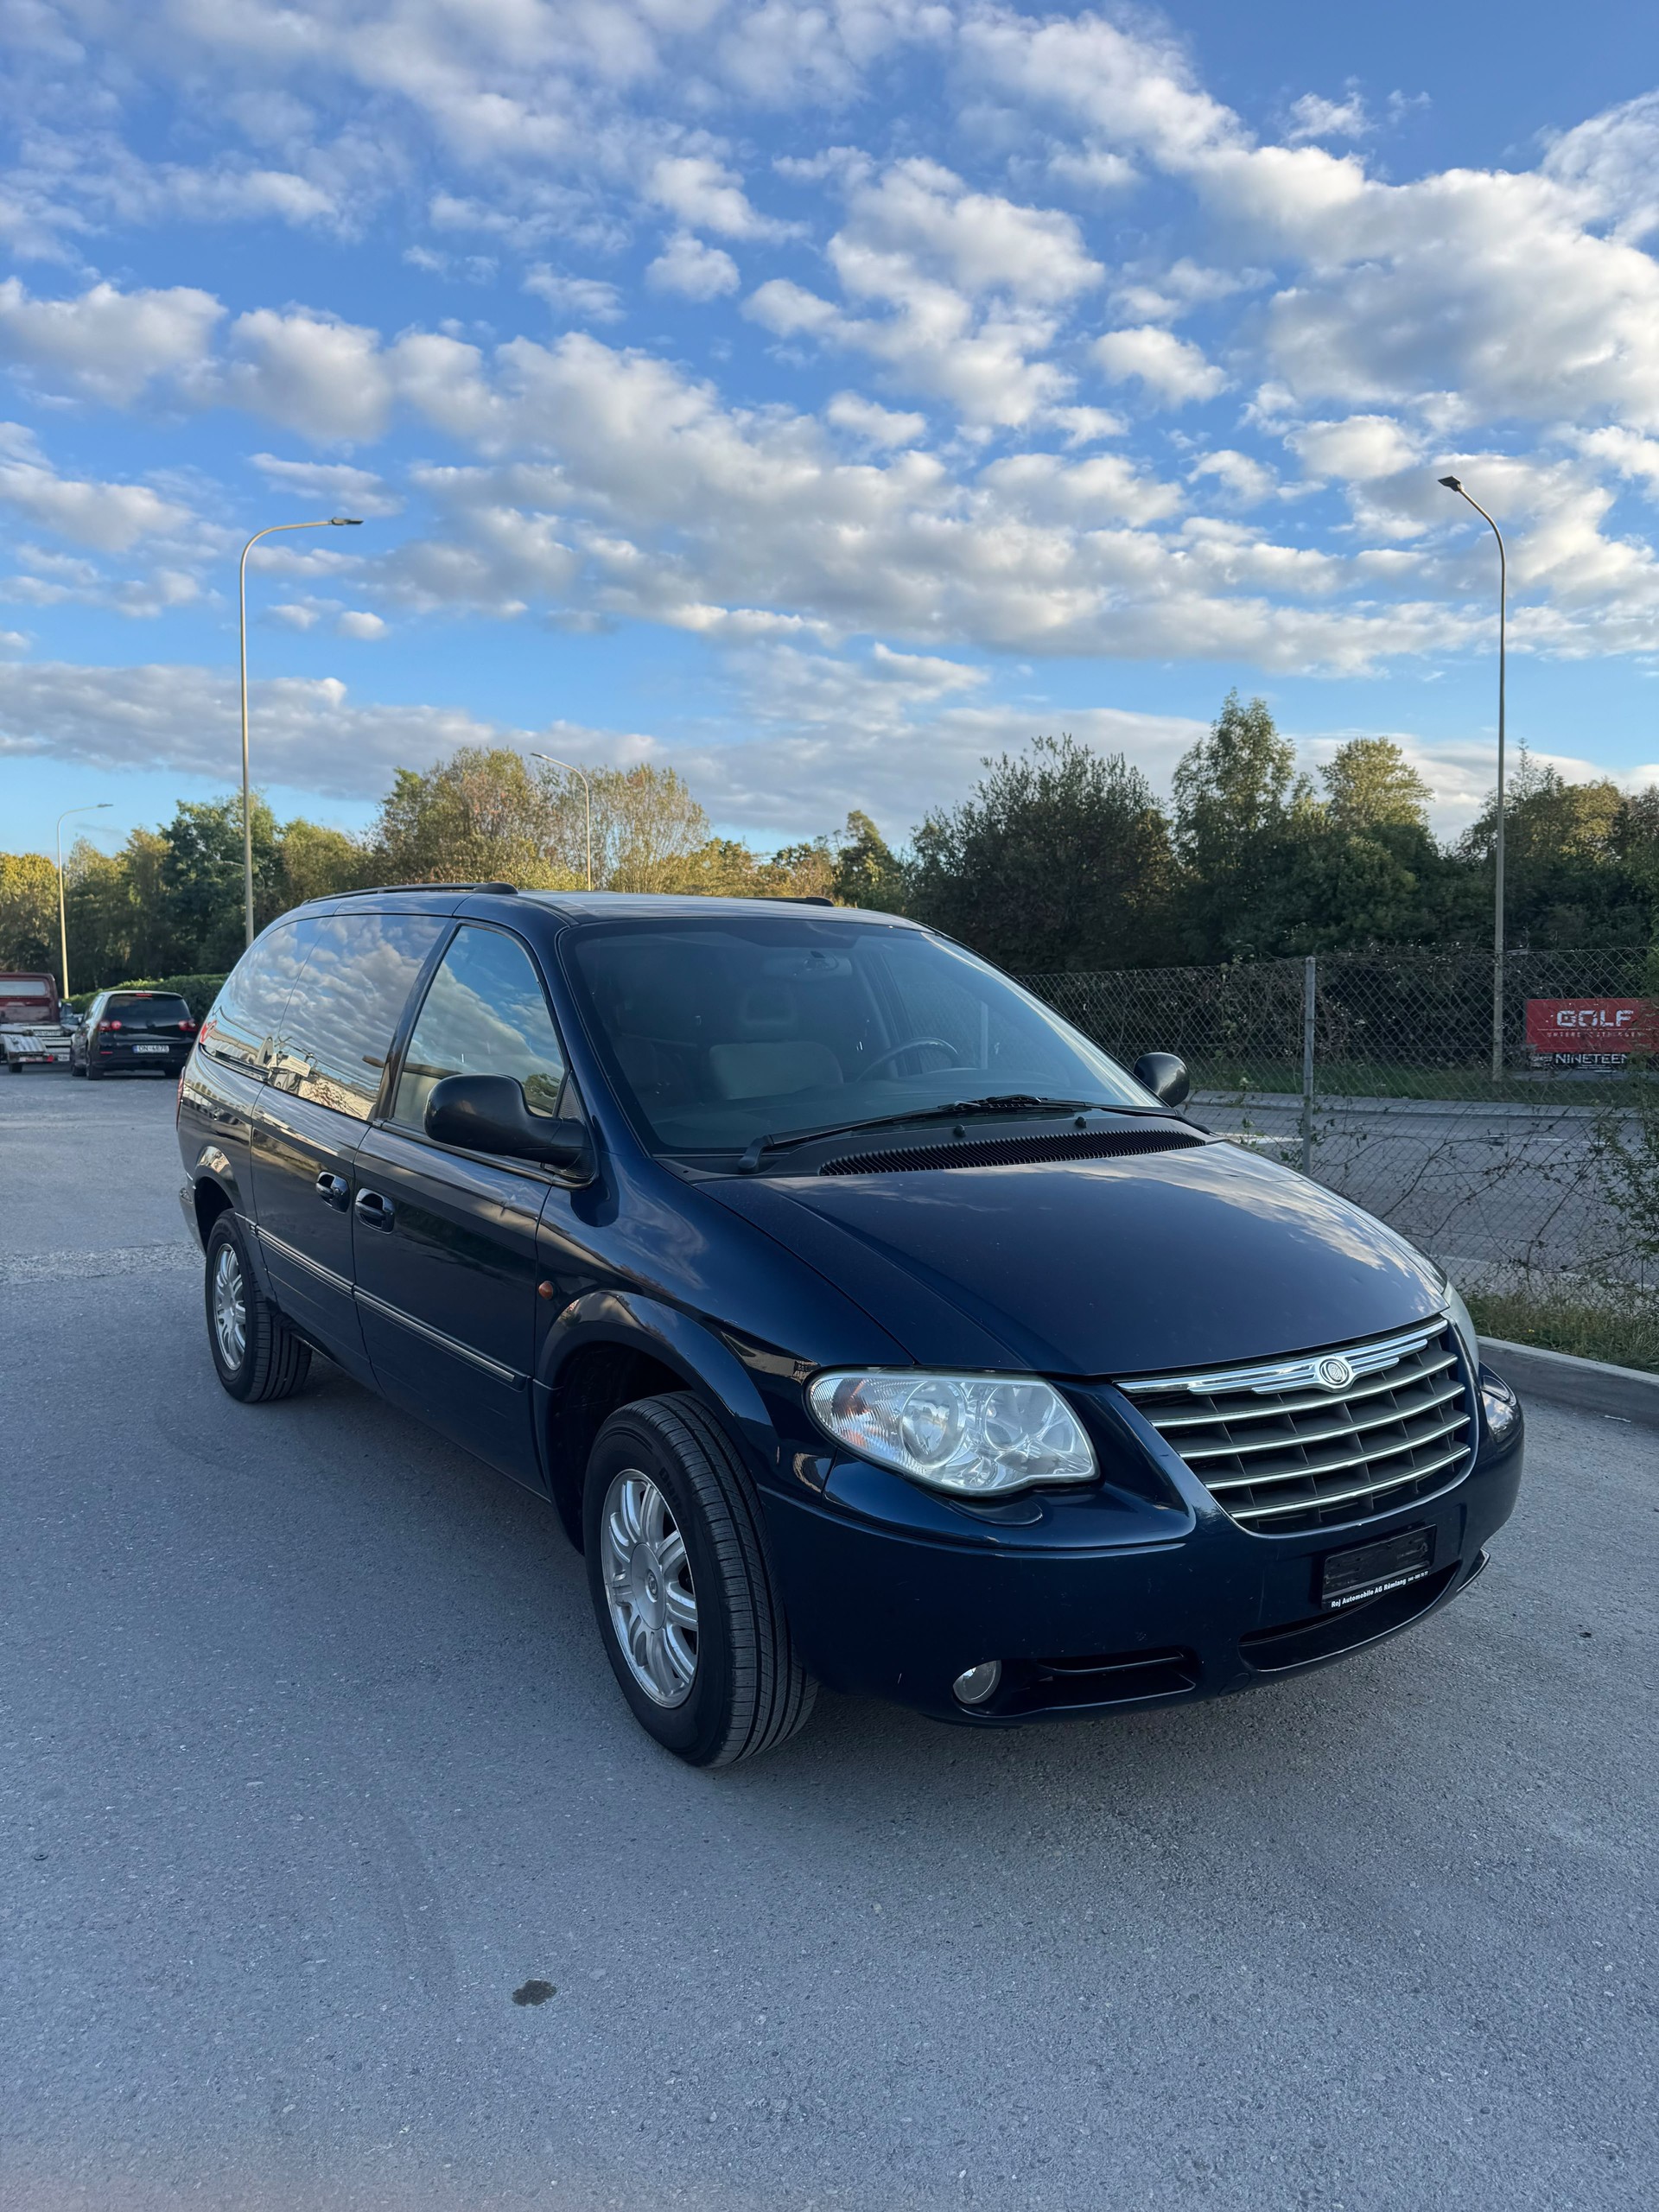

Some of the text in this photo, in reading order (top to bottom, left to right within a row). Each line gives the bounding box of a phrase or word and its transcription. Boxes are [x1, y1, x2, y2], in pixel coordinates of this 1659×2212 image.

[1556, 1009, 1634, 1027] GOLF
[1342, 1589, 1374, 1604] Automobile
[1375, 1586, 1382, 1594] AG
